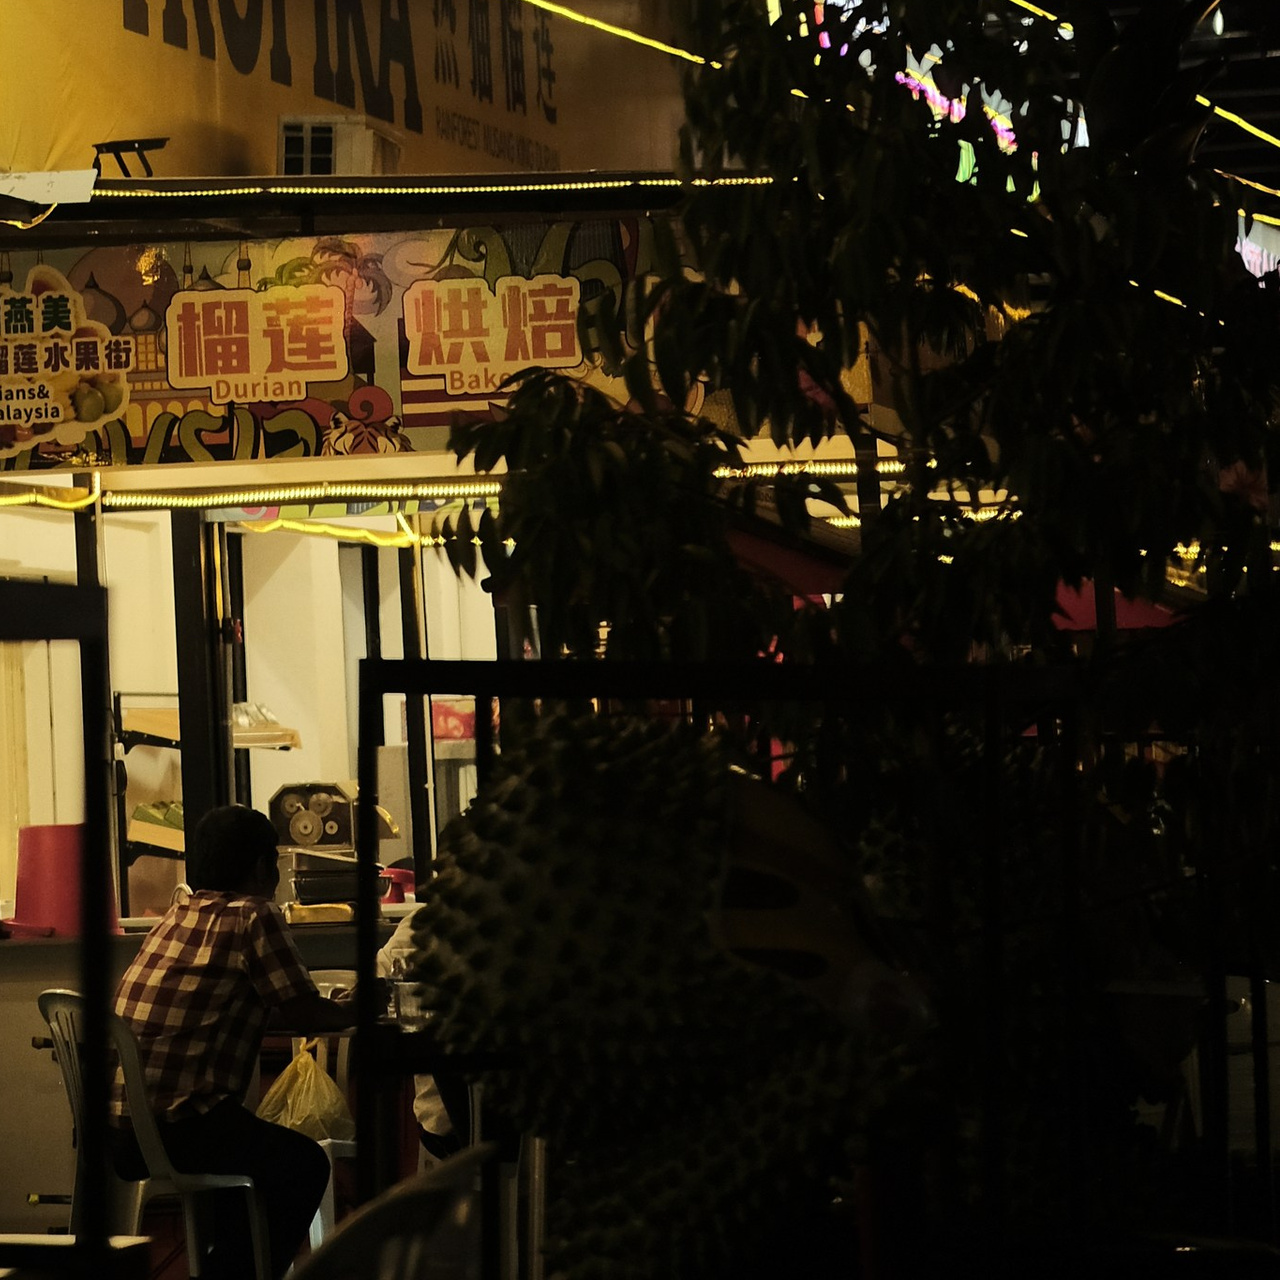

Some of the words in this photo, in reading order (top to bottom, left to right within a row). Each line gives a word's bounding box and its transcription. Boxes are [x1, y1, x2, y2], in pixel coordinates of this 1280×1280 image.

[177, 295, 338, 378] 榴莲
[414, 282, 576, 366] 烘焙
[214, 375, 303, 401] Durian
